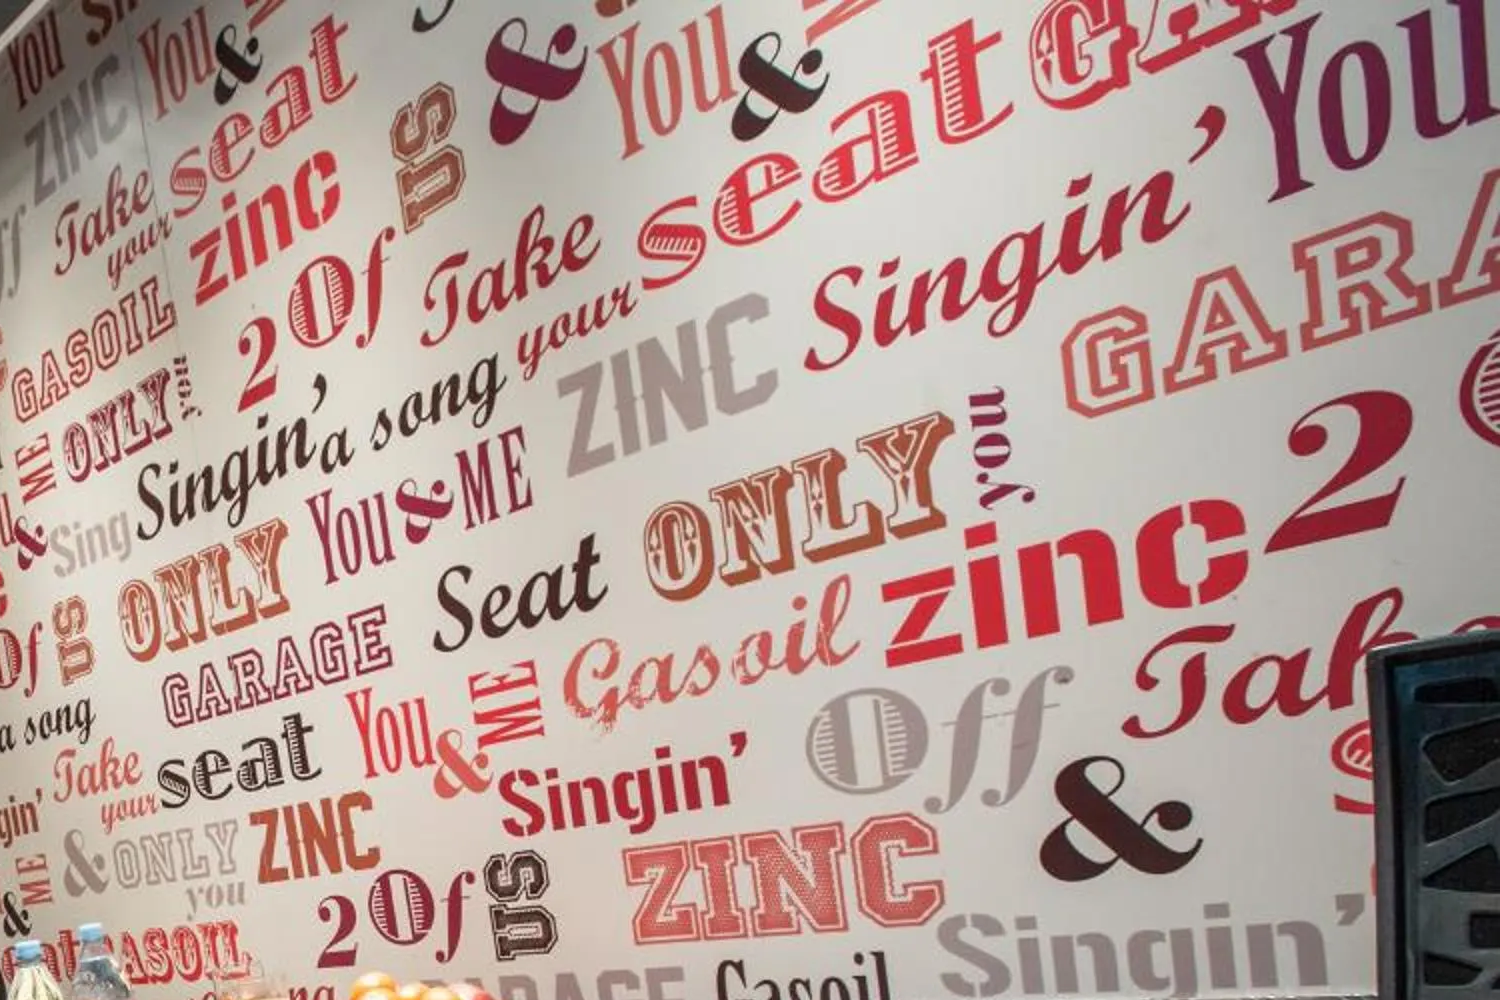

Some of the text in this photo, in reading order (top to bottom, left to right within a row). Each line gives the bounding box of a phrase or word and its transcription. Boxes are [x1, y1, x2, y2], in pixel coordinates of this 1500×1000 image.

[6, 8, 66, 112] You
[137, 8, 216, 122] You
[213, 23, 263, 105] &
[169, 14, 358, 219] seat
[485, 17, 589, 146] &
[596, 5, 830, 161] You &
[1233, 0, 1500, 203] You
[24, 51, 128, 207] ZINC
[390, 81, 467, 234] US
[638, 17, 1015, 291] seat
[54, 163, 173, 291] Take your
[189, 150, 341, 307] zinc
[420, 204, 639, 381] Take your
[11, 276, 176, 424] GASOIL
[319, 425, 355, 475] a
[369, 352, 507, 452] song
[557, 292, 780, 478] ZINC
[15, 432, 57, 505] ME
[62, 367, 174, 483] ONLY
[13, 515, 49, 570] &
[50, 510, 133, 578] Sing
[305, 425, 534, 586] You & ME
[643, 385, 1036, 602] ONLY you
[117, 517, 291, 663] ONLY
[433, 531, 610, 654] Seat
[881, 498, 1249, 669] zinc
[161, 604, 394, 728] GARAGE
[562, 573, 861, 733] Gasoil
[1121, 586, 1500, 741] Tak
[23, 696, 97, 745] song
[53, 712, 323, 835] Take your seat
[345, 658, 546, 799] You & ME
[805, 665, 1076, 815] Off
[15, 853, 54, 907] ME
[62, 819, 246, 920] & ONLY you
[249, 790, 382, 884] ZINC
[622, 812, 946, 946] ZINC
[1039, 755, 1203, 882] &
[3, 891, 33, 938] &
[483, 849, 559, 962] US
